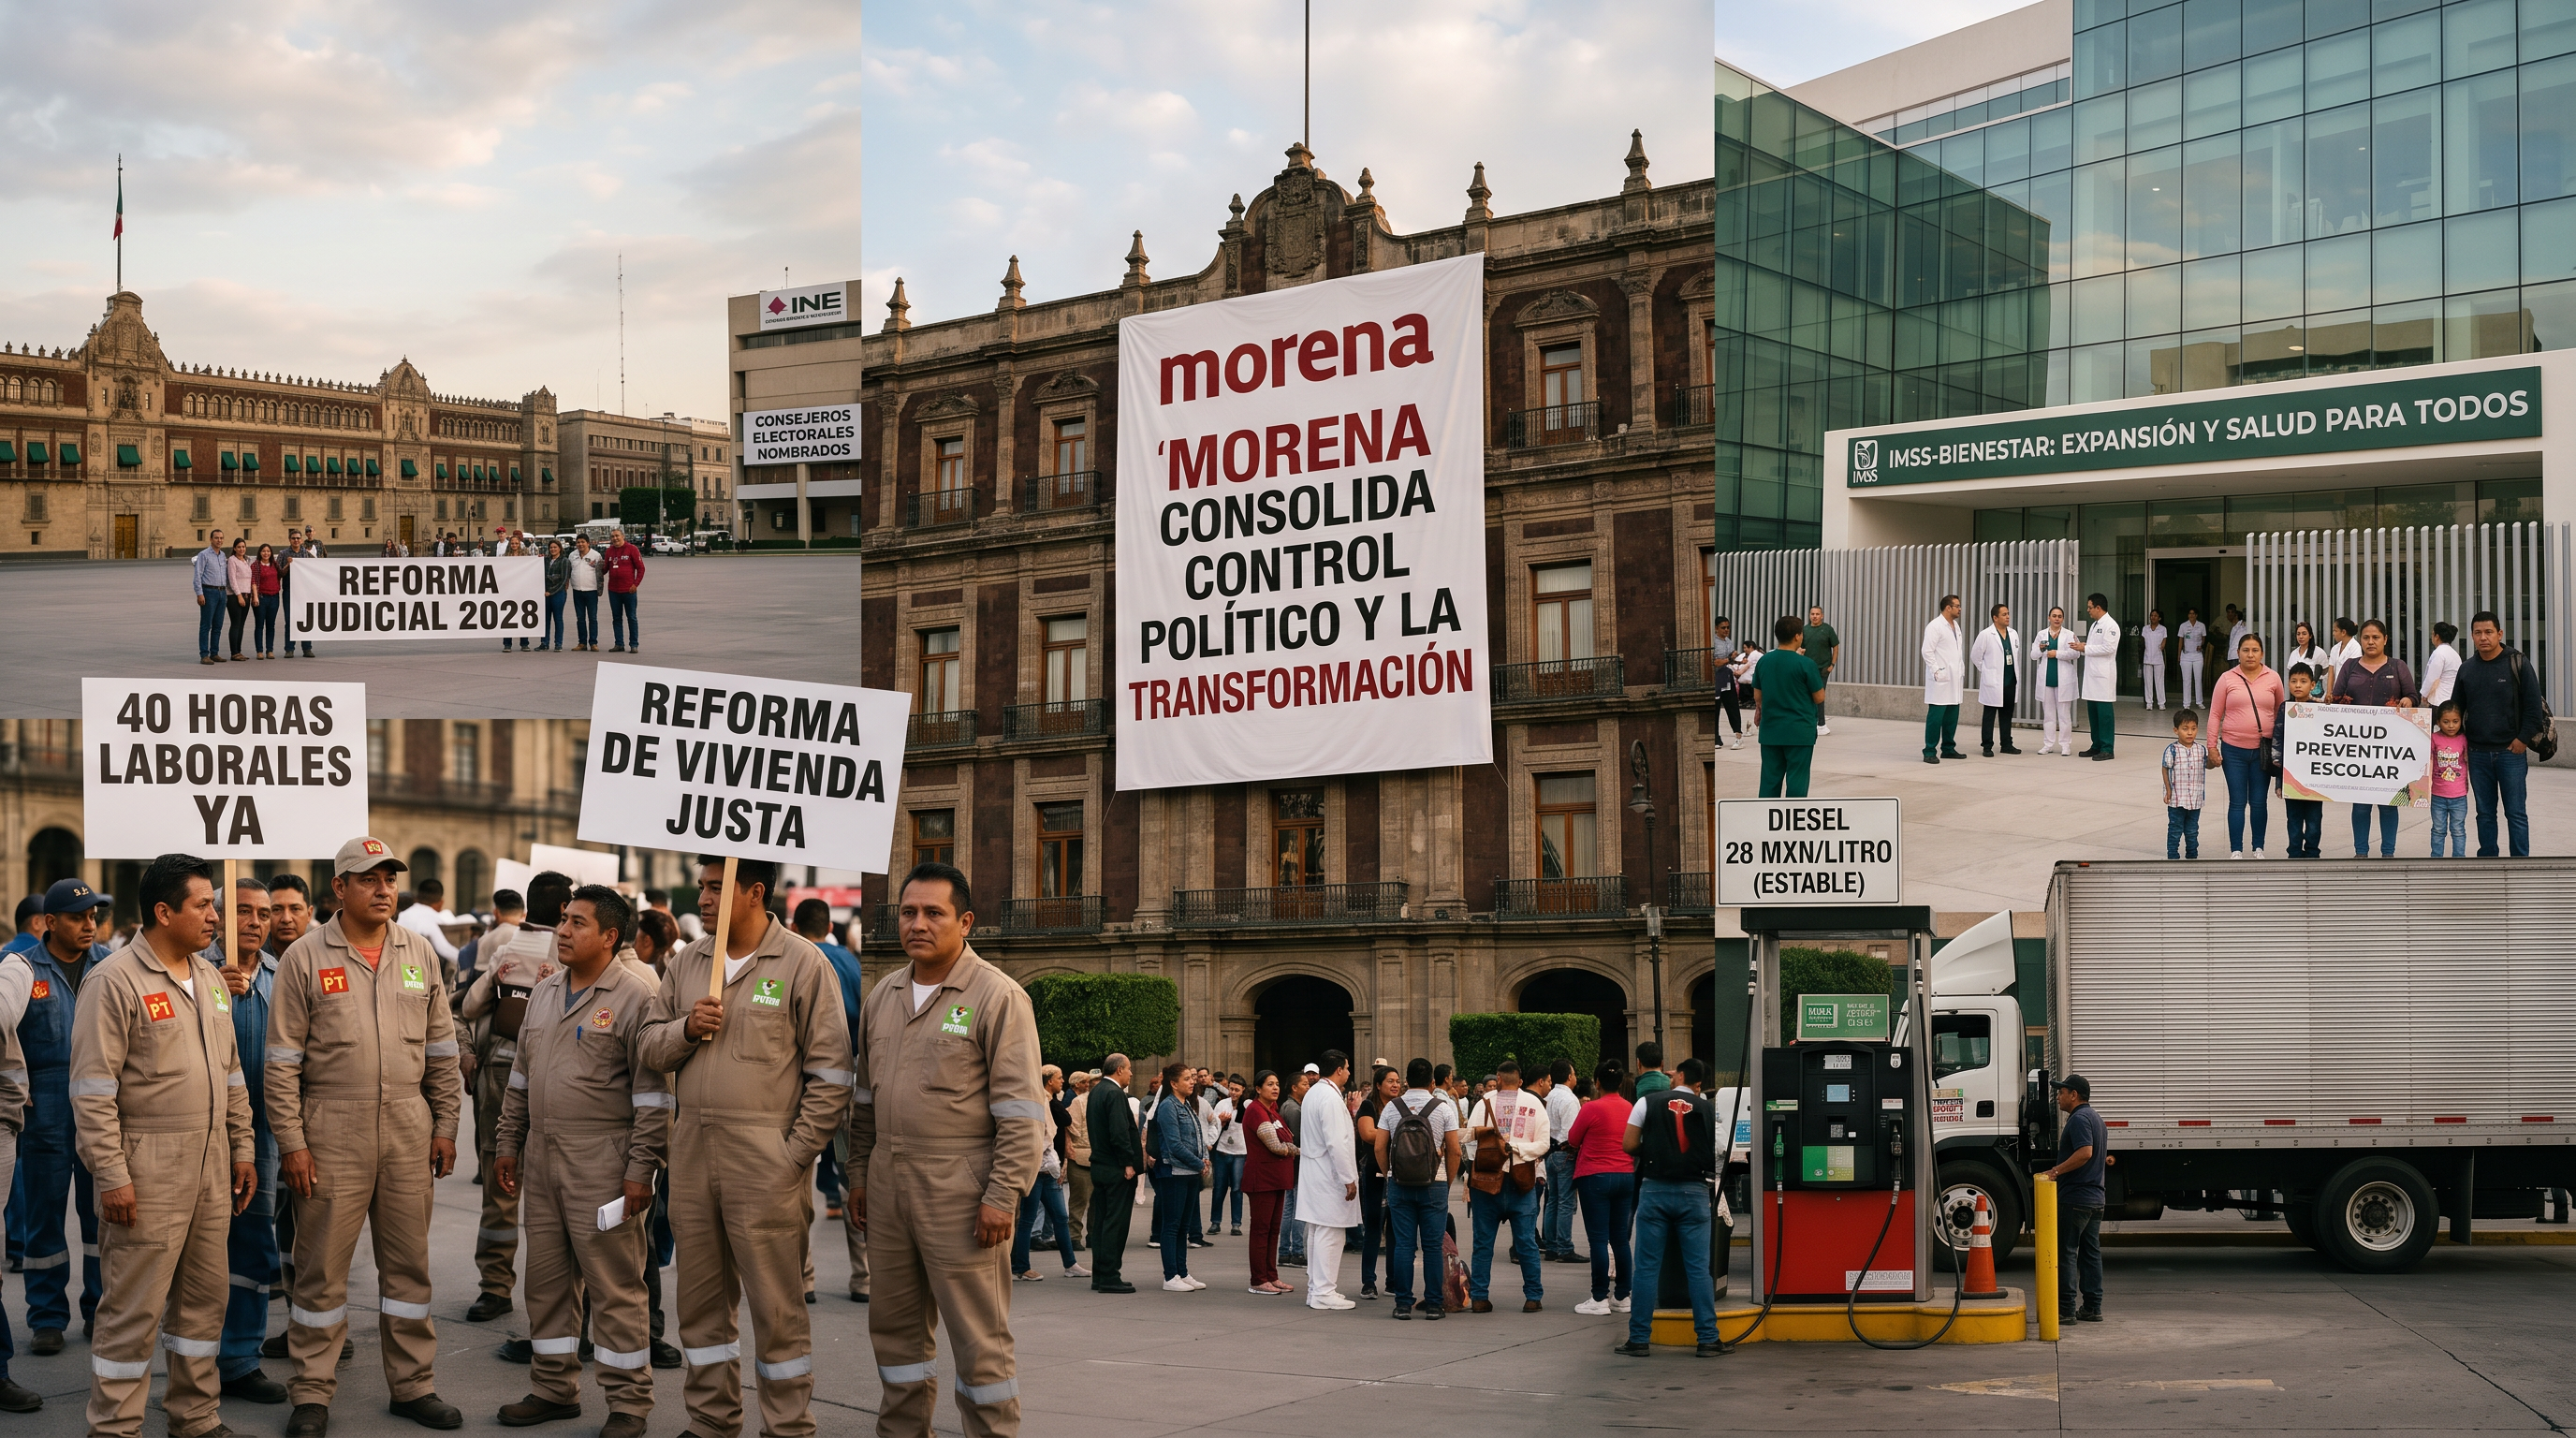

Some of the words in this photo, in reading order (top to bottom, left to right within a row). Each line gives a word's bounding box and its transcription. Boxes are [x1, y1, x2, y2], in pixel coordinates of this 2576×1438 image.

[792, 291, 841, 314] INE
[1161, 314, 1434, 405] morena
[755, 410, 850, 427] CONSEJEROS
[1890, 436, 2055, 468] IMSS-BIENESTAR:
[2063, 418, 2194, 454] EXPANSIÓN
[2203, 419, 2219, 442] Y
[2227, 411, 2316, 440] SALUD
[2327, 403, 2407, 432] PARA
[2415, 390, 2528, 424] TODOS
[754, 426, 854, 443] ELECTORALES
[758, 444, 850, 460] NOMBRADOS
[1853, 469, 1878, 483] IMSS
[1161, 469, 1435, 546] CONSOLIDA
[340, 565, 499, 595] REFORMA
[1186, 533, 1410, 600] CONTROL
[297, 601, 447, 632] JUDICIAL
[460, 600, 538, 629] 2028
[1142, 600, 1339, 664] POLÍTICO
[1354, 595, 1384, 640] Y
[1401, 588, 1461, 637] LA
[1129, 641, 1472, 721] TRANSFORMACIÓN
[117, 693, 170, 733] 40
[189, 694, 332, 736] HORAS
[641, 682, 859, 745] REFORMA
[2324, 724, 2387, 739] SALUD
[100, 743, 351, 786] LABORALES
[2296, 741, 2416, 760] PREVENTIVA
[602, 732, 660, 778] DE
[677, 740, 885, 802] VIVIENDA
[2311, 762, 2398, 779] ESCOLAR
[193, 795, 264, 844] YA
[666, 794, 805, 848] JUSTA
[1769, 808, 1850, 830] DIESEL
[1726, 842, 1753, 864] 28
[1762, 840, 1891, 863] MXN/LITRO
[1754, 872, 1865, 899] (ESTABLE)
[324, 976, 344, 990] PT
[150, 1002, 169, 1018] PT
